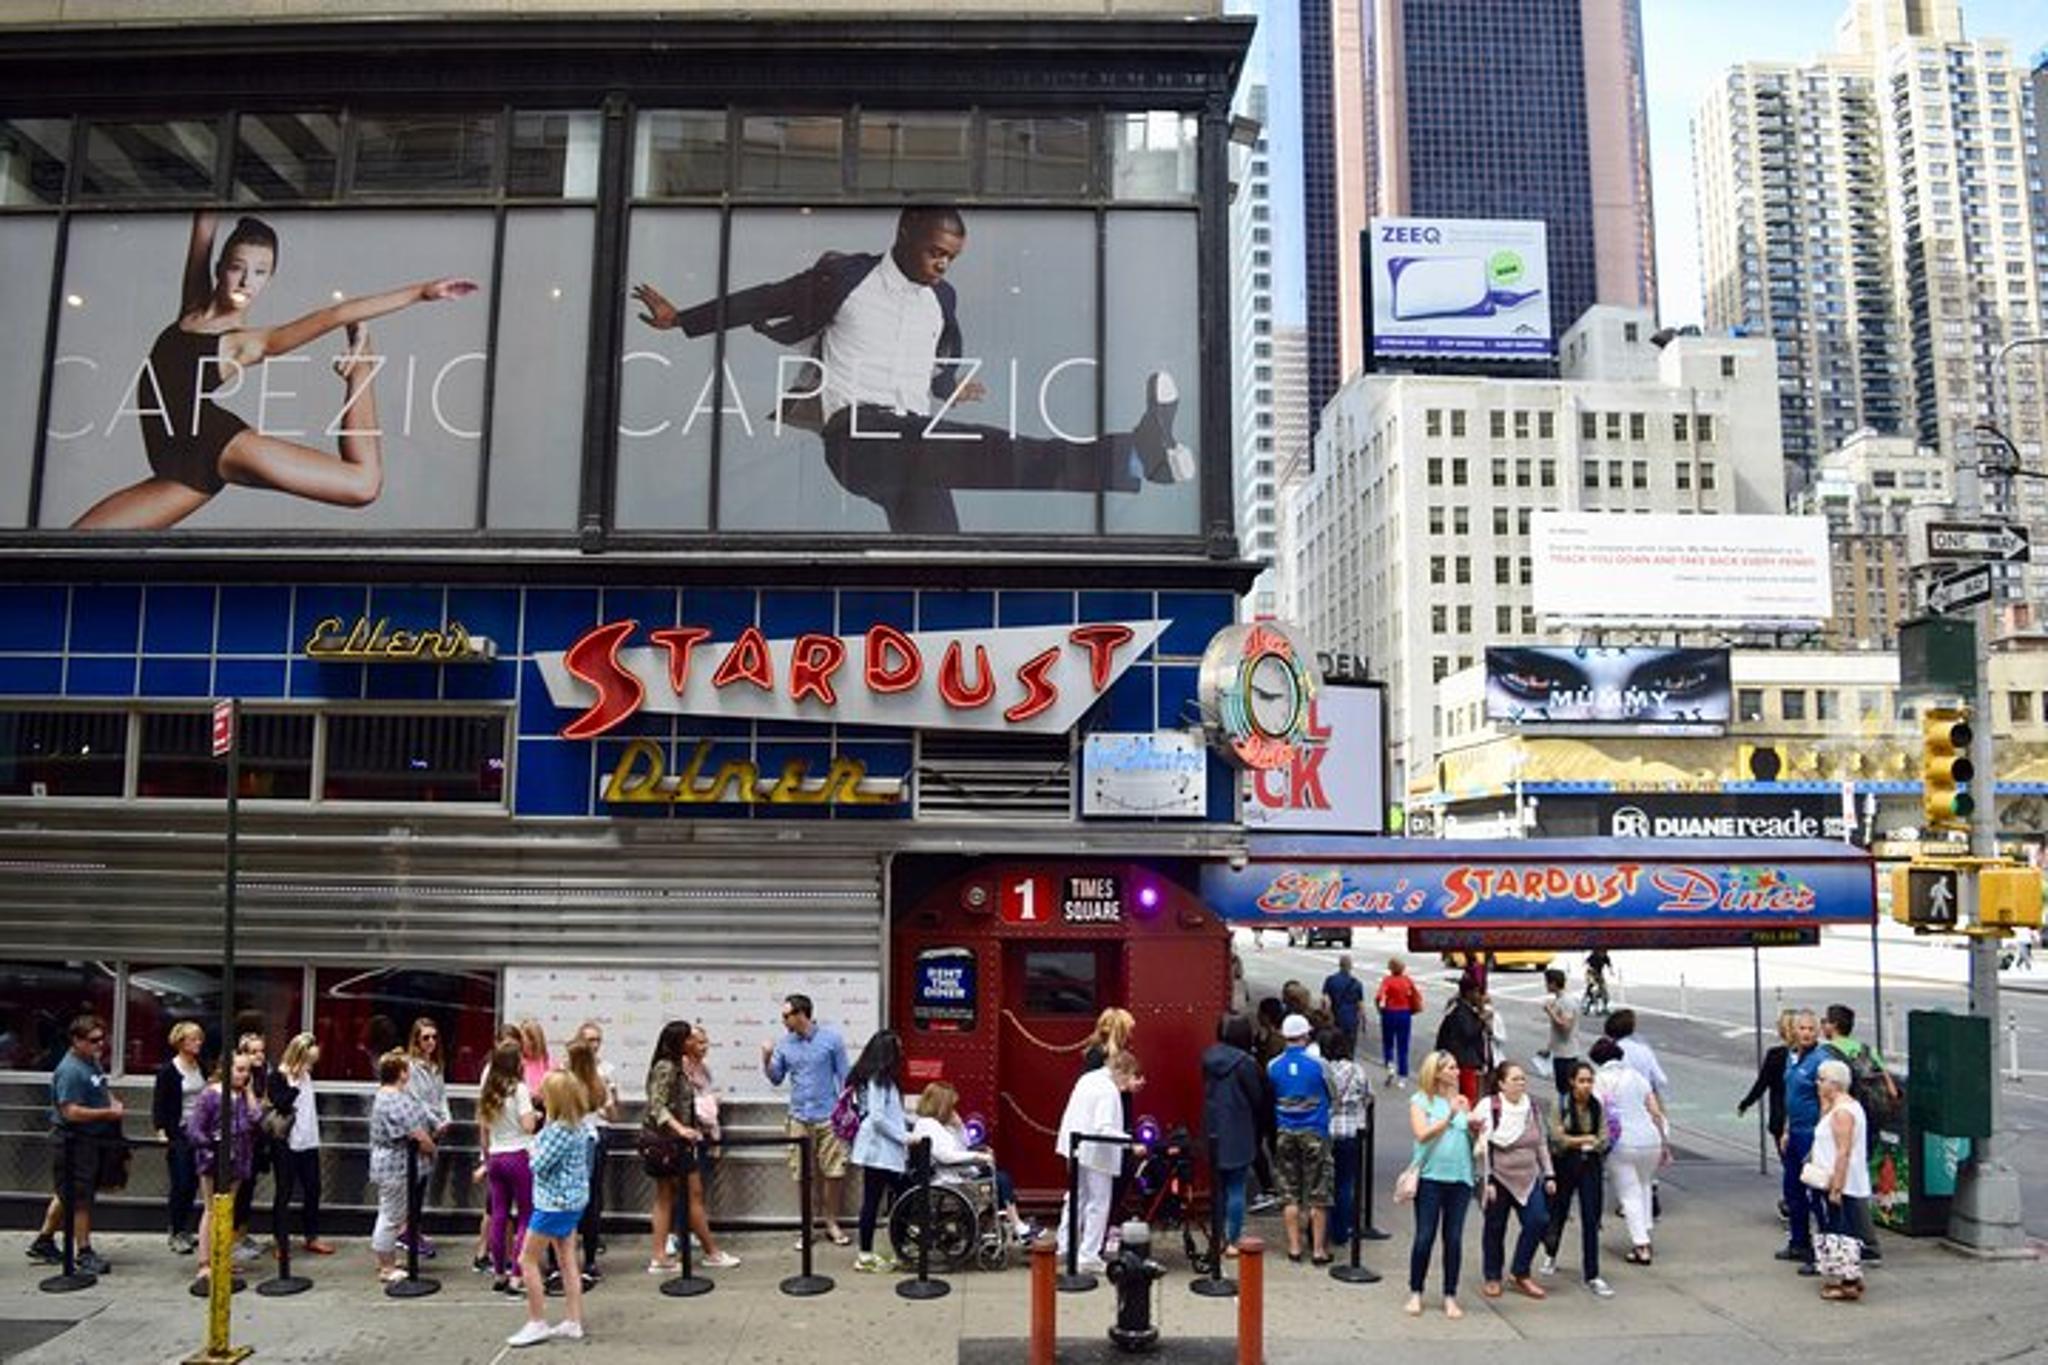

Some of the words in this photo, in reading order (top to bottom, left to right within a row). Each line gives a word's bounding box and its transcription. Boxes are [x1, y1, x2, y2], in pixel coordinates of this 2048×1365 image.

[1381, 227, 1441, 243] ZEEQ
[1936, 534, 1968, 549] ONE
[560, 619, 1135, 740] STARDUST
[1550, 685, 1669, 708] MUMMY
[1070, 878, 1114, 898] TIMES
[1257, 870, 1426, 913] Ellen's
[1443, 864, 1642, 918] STARDUST
[1652, 864, 1816, 913] Diner
[1013, 878, 1037, 920] 1
[1064, 901, 1121, 921] SQUARE
